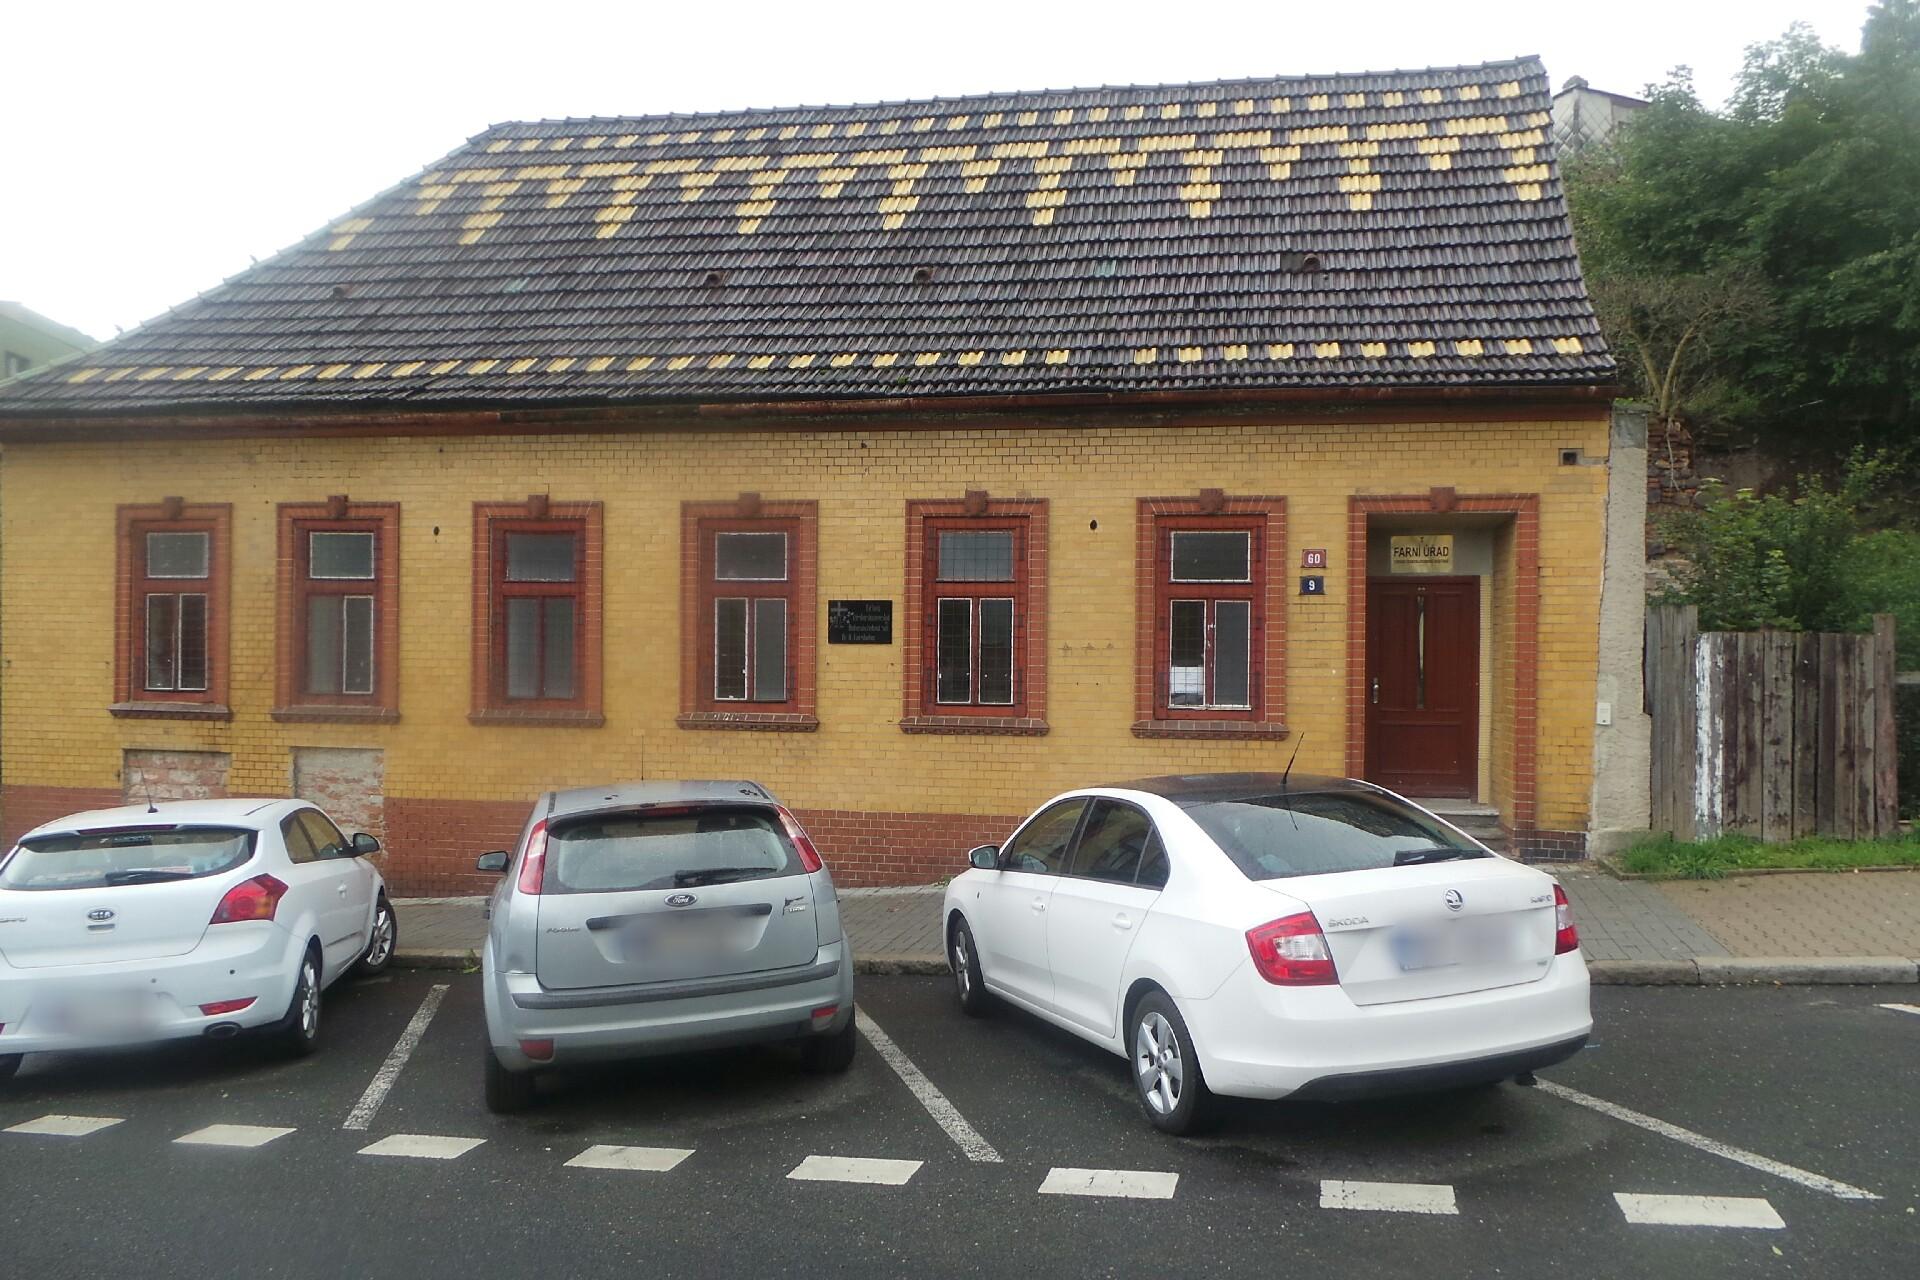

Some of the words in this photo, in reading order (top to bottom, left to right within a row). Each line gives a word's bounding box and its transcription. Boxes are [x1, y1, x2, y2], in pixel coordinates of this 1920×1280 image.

[1393, 544, 1421, 557] FARNÍ
[1307, 553, 1321, 564] 60
[1308, 579, 1316, 591] 9
